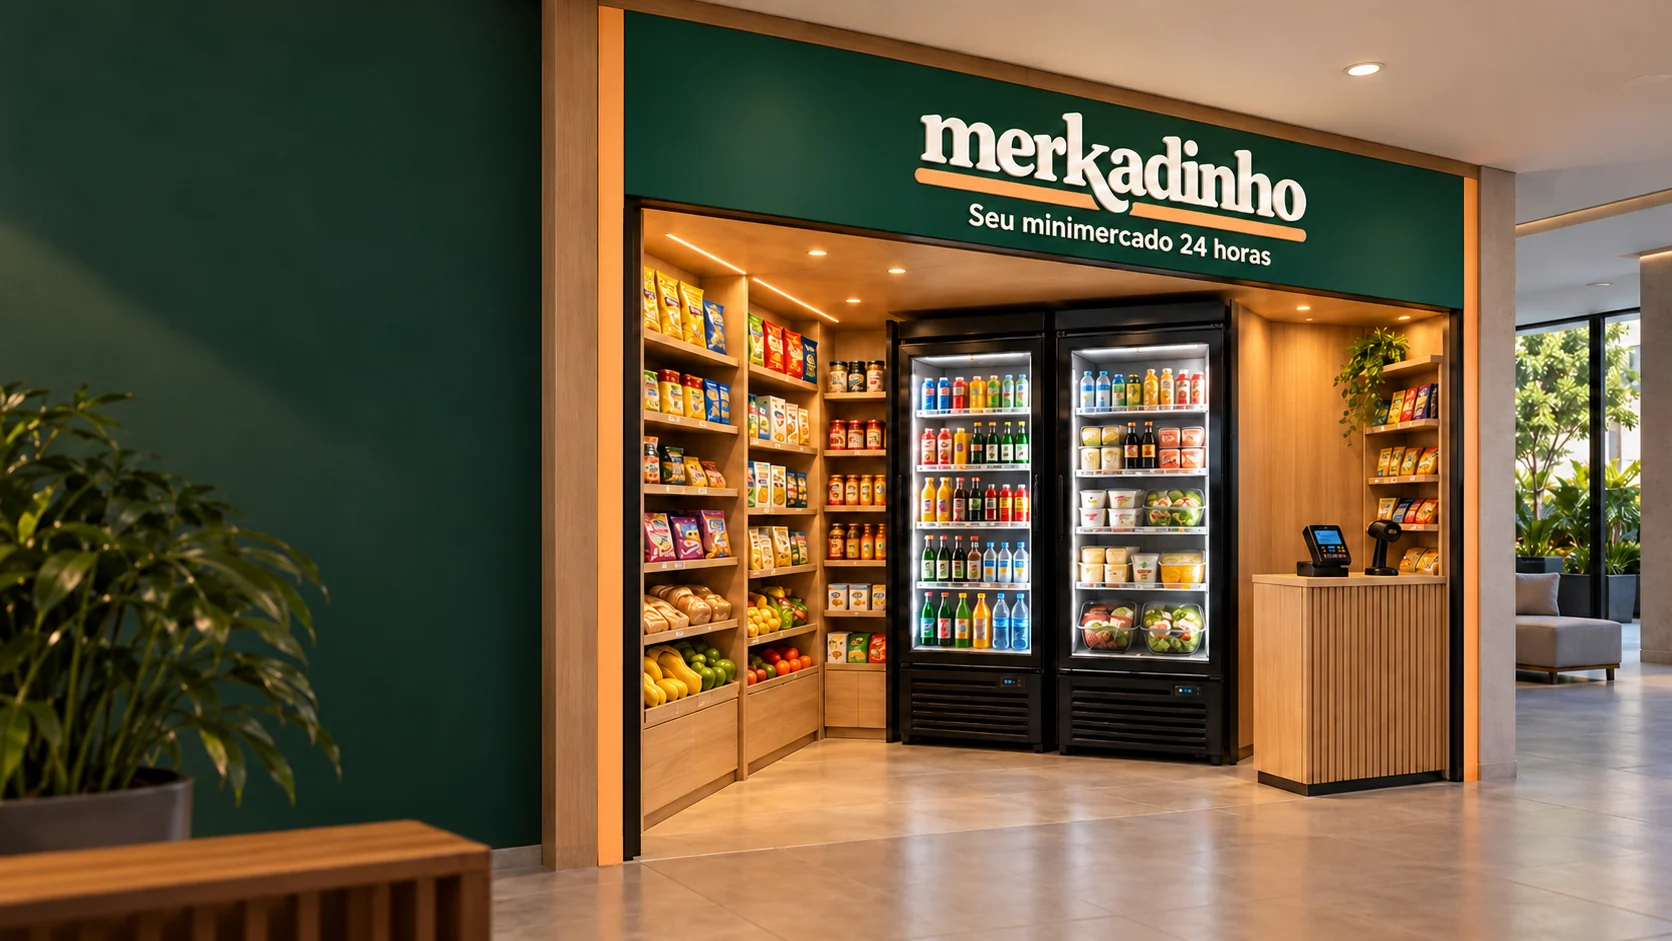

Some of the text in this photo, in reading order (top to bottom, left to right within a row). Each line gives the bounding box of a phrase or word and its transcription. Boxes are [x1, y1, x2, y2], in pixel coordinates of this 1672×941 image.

[920, 112, 1307, 222] merkadinho
[968, 202, 1272, 267] Seu minimercado 24 horas
